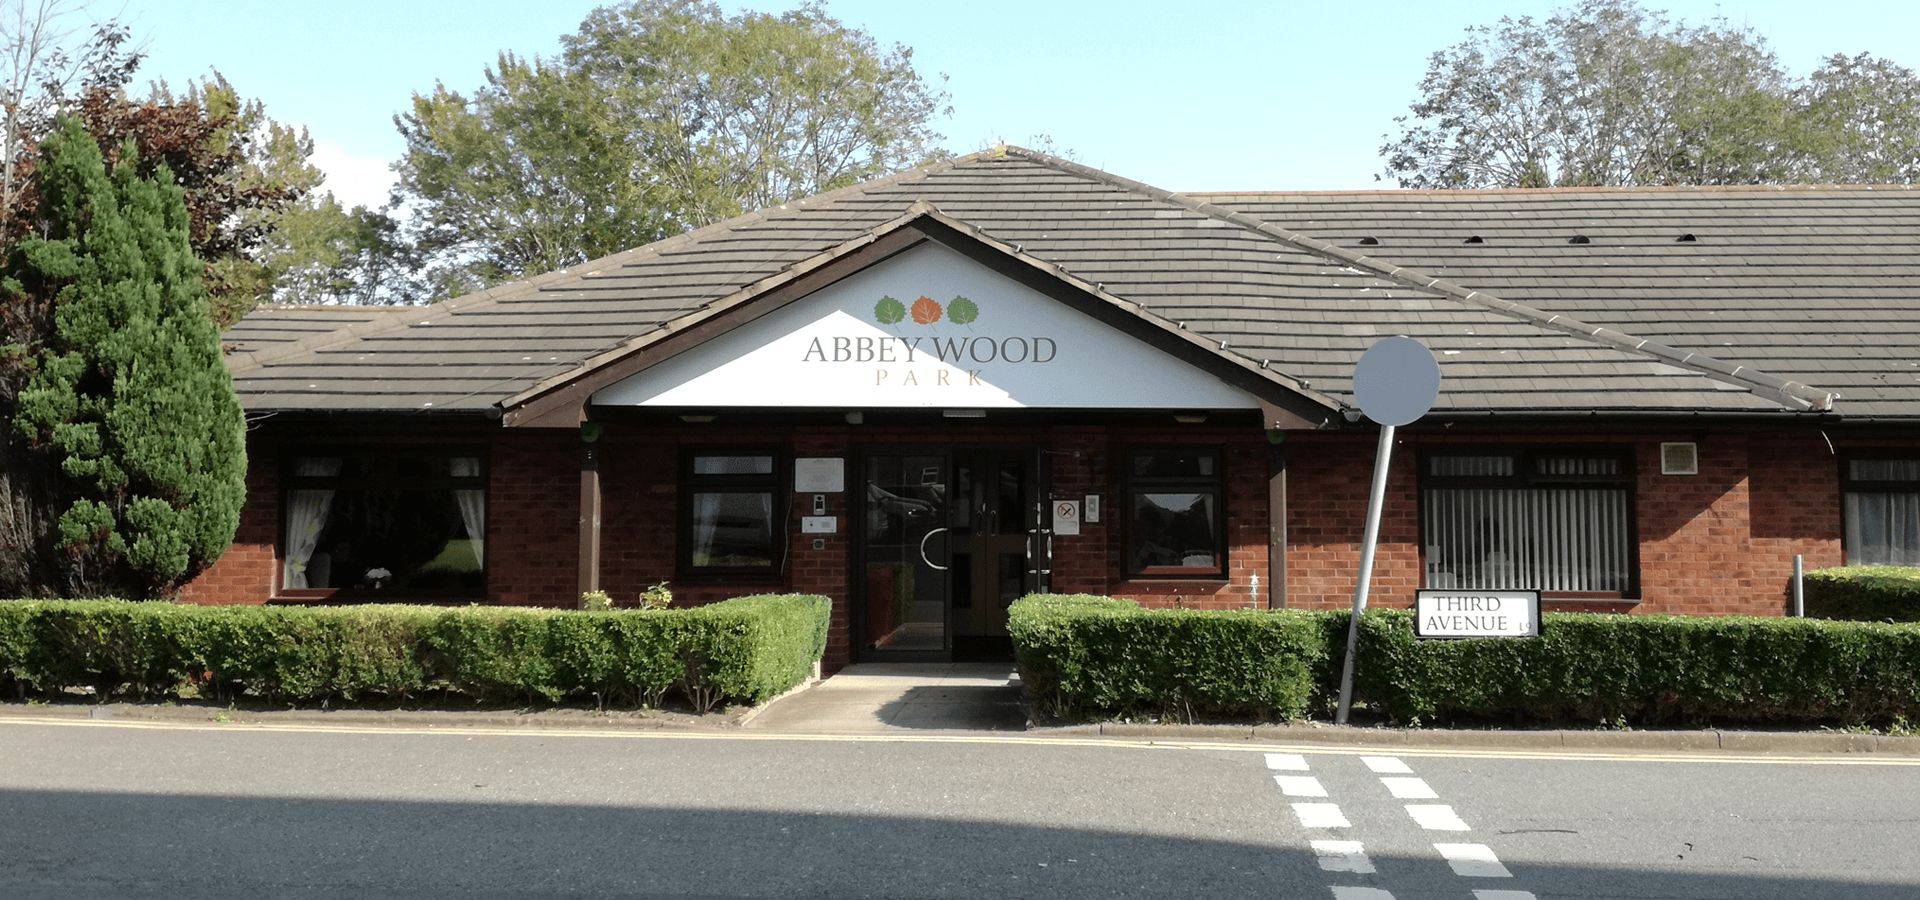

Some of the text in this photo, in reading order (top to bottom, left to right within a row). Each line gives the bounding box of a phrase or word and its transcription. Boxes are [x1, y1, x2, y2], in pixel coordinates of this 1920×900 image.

[802, 336, 1057, 363] ABBEY WOOD
[876, 369, 982, 386] PARK
[1432, 596, 1501, 611] THIRD
[1426, 615, 1532, 631] AVENUE L9
